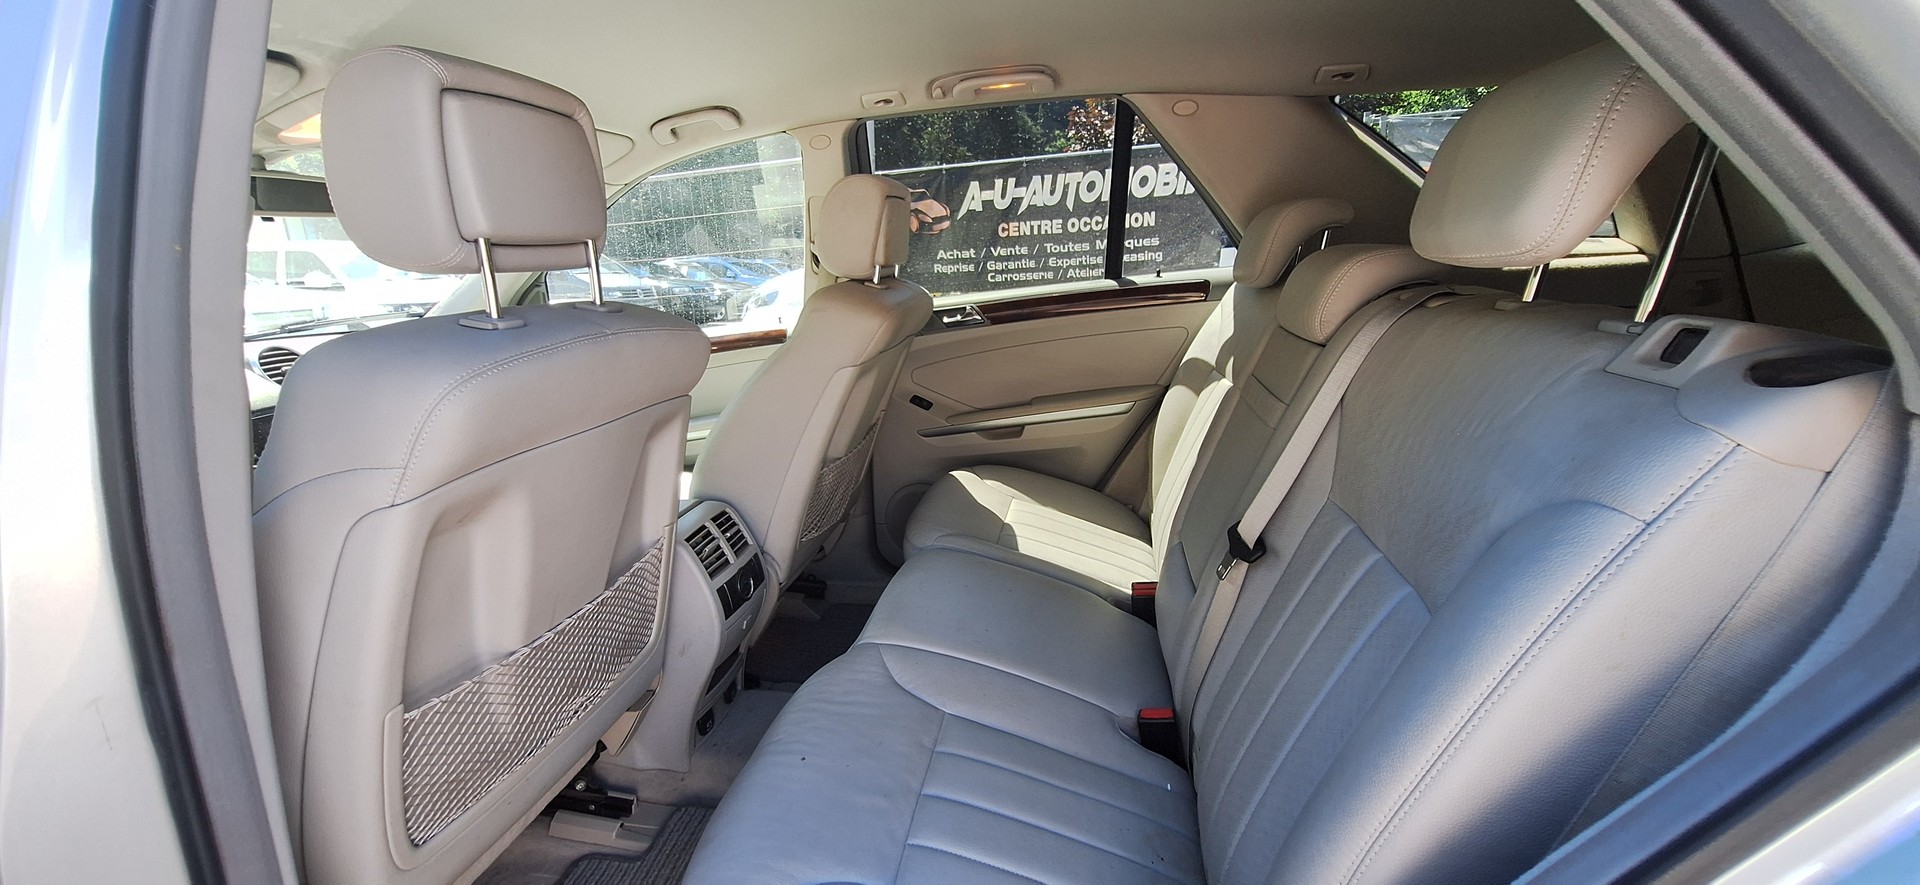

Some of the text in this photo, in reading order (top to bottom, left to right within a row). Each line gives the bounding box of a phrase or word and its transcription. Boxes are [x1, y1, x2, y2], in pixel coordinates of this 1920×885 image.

[998, 211, 1156, 238] CENTRE OCCION
[936, 236, 1160, 260] Achat / Vente / Toutes Mques
[934, 250, 1163, 274] Reprise / Garantie / Expertise easing
[987, 265, 1105, 283] Carrosserie / Atelier
